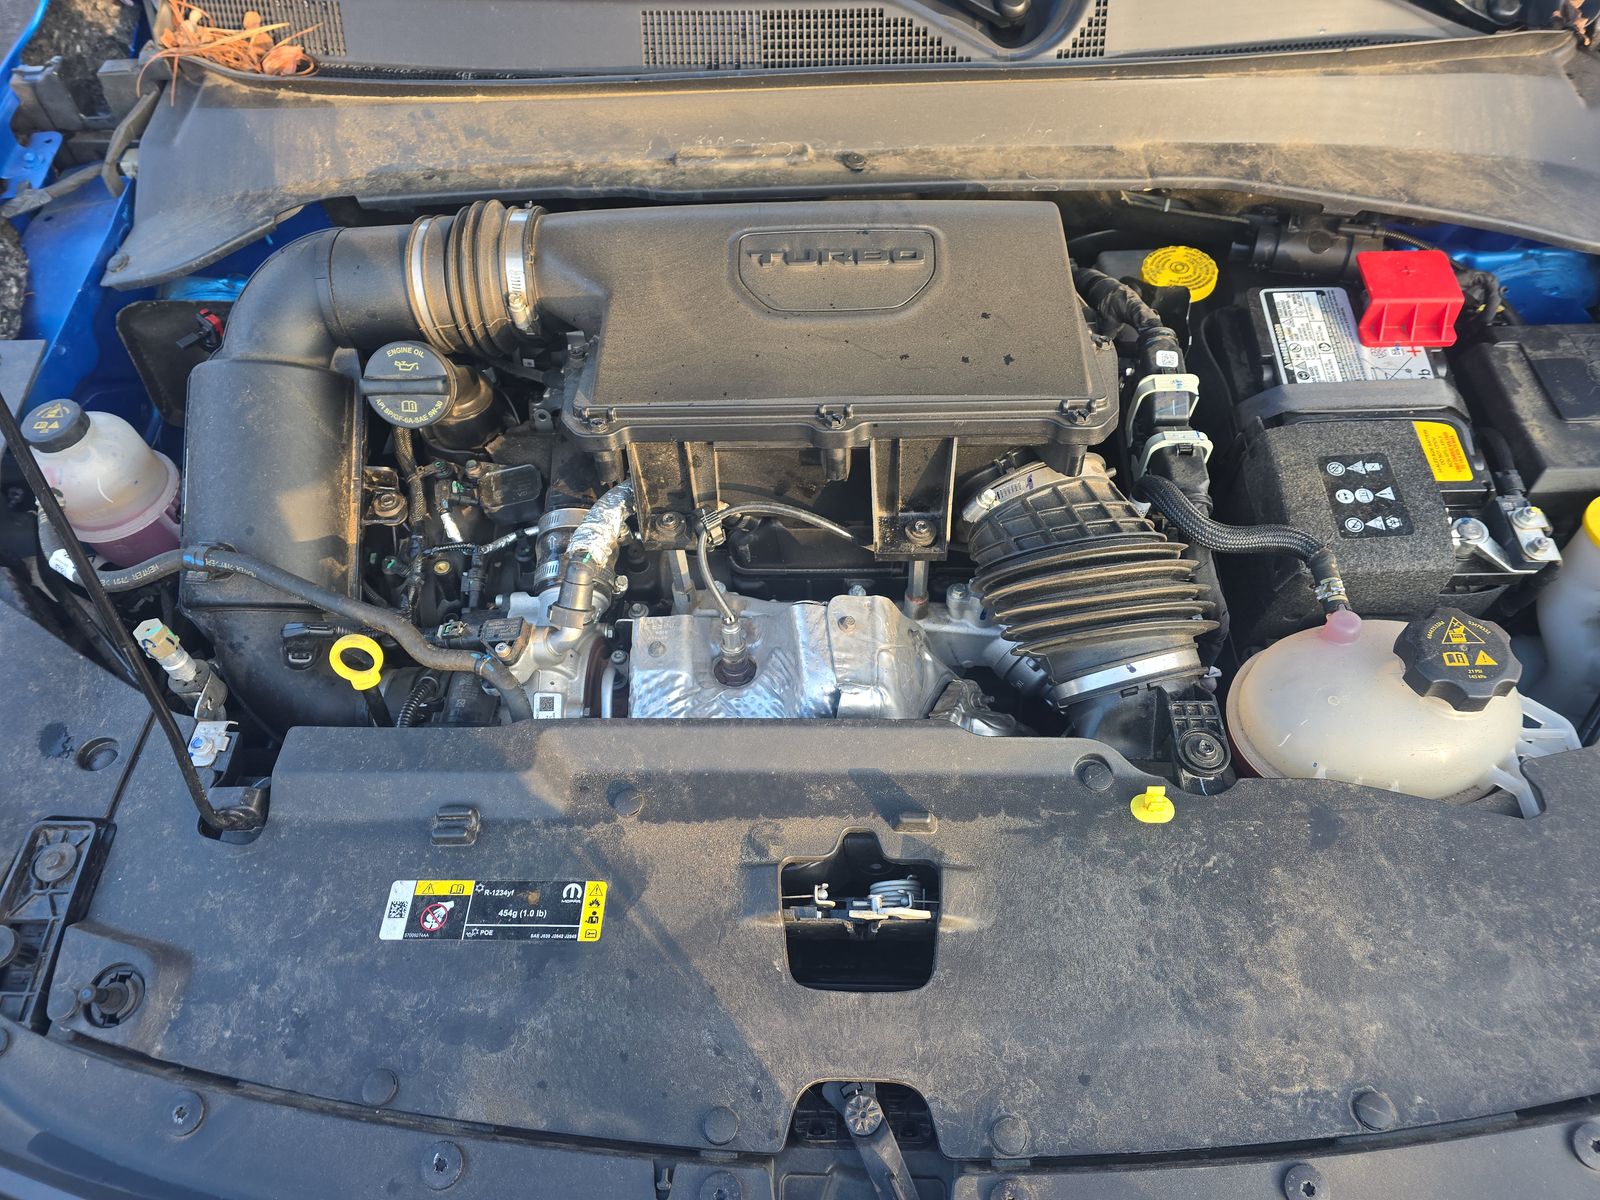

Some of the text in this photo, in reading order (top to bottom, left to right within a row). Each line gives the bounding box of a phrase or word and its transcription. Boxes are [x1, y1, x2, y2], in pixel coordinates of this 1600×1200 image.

[749, 248, 926, 267] TURBO
[386, 346, 425, 359] ENGINE OIL
[375, 398, 385, 410] API
[428, 400, 444, 417] 5W-30
[131, 564, 160, 582] HEATER
[498, 909, 547, 918] 454g (1.0 lb)
